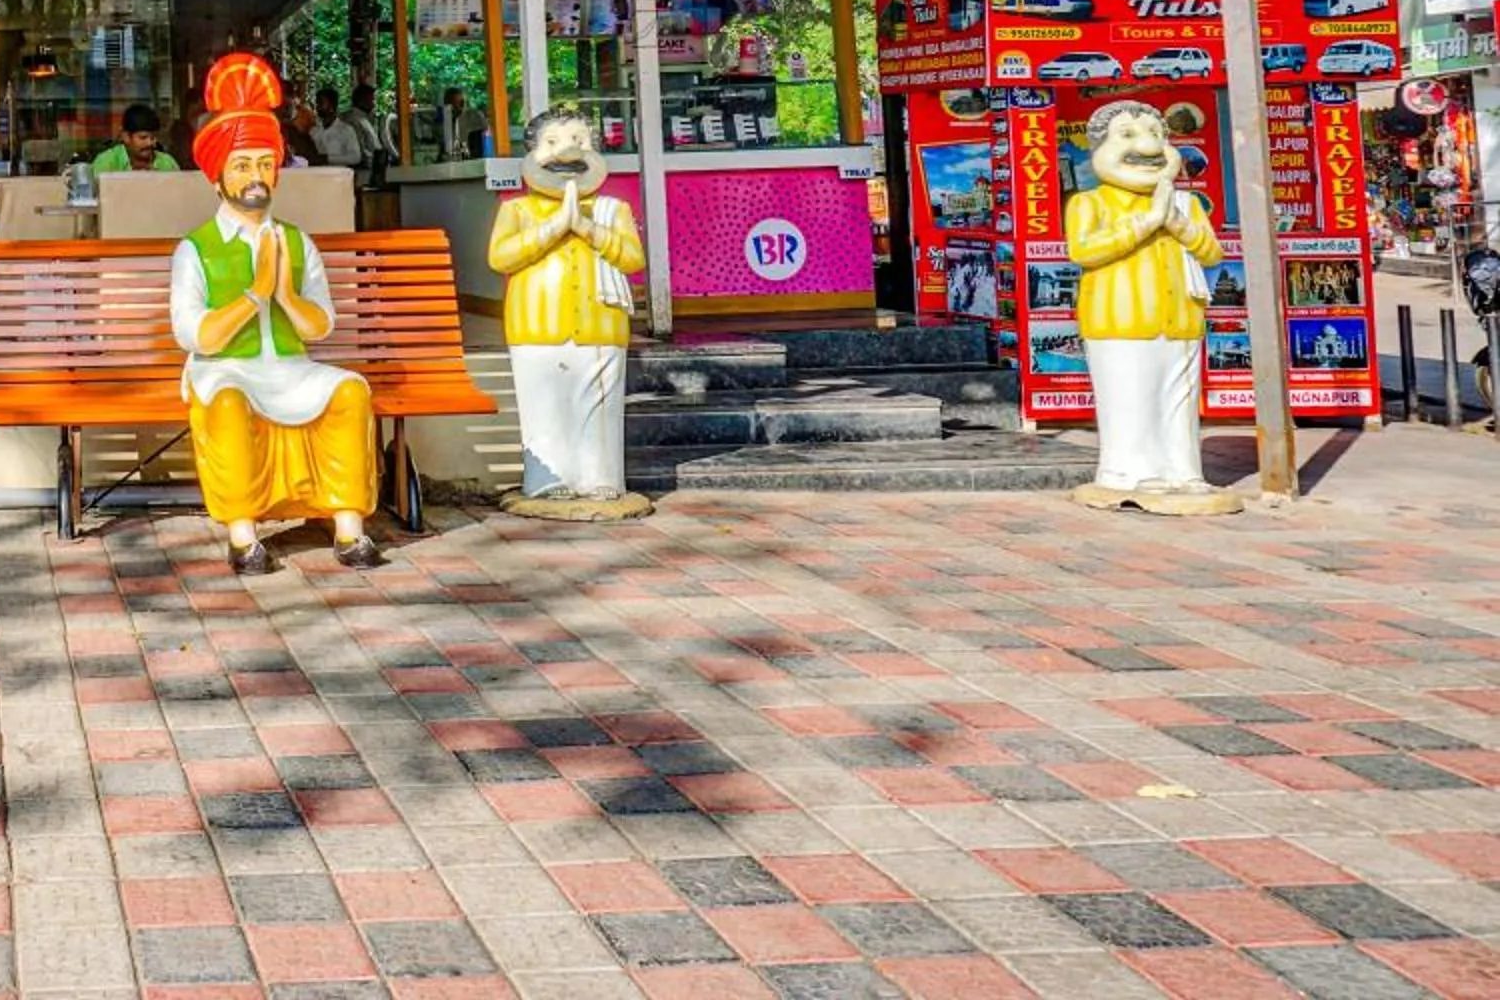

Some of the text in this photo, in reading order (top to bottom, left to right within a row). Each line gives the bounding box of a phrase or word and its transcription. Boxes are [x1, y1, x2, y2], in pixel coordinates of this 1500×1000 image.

[1118, 25, 1176, 39] Tours
[1181, 25, 1197, 38] &
[1019, 113, 1050, 235] TRAVELS
[1321, 108, 1357, 230] TRAVELS
[752, 233, 798, 266] BR
[1039, 394, 1096, 406] MUMBA
[1219, 391, 1361, 405] SHAN NGNAPUR
